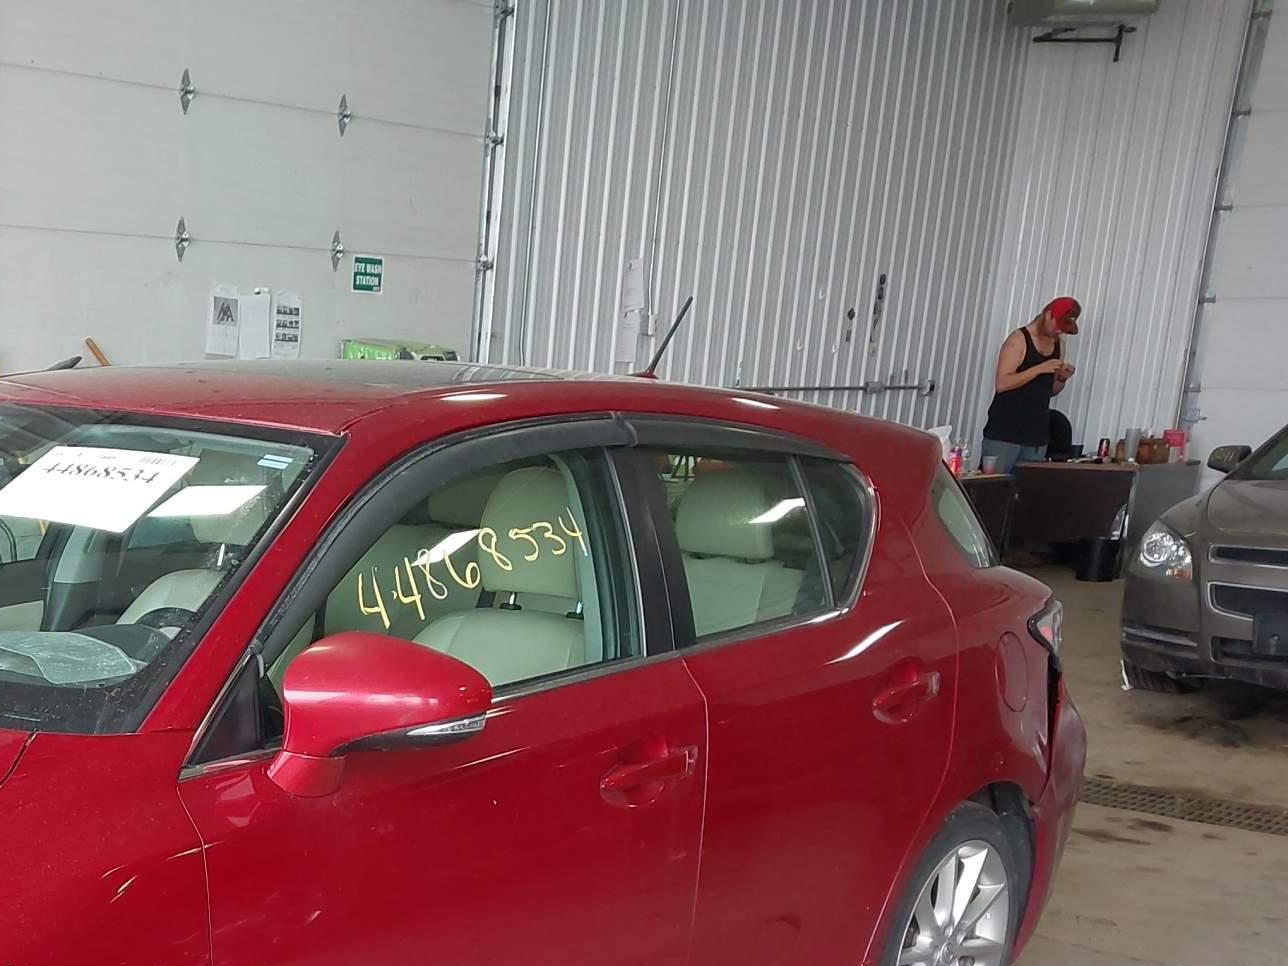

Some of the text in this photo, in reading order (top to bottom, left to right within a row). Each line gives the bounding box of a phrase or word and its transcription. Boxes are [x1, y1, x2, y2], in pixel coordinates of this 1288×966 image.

[355, 263, 382, 274] EYE WASH
[356, 275, 379, 286] STATION
[357, 506, 588, 629] 44868534
